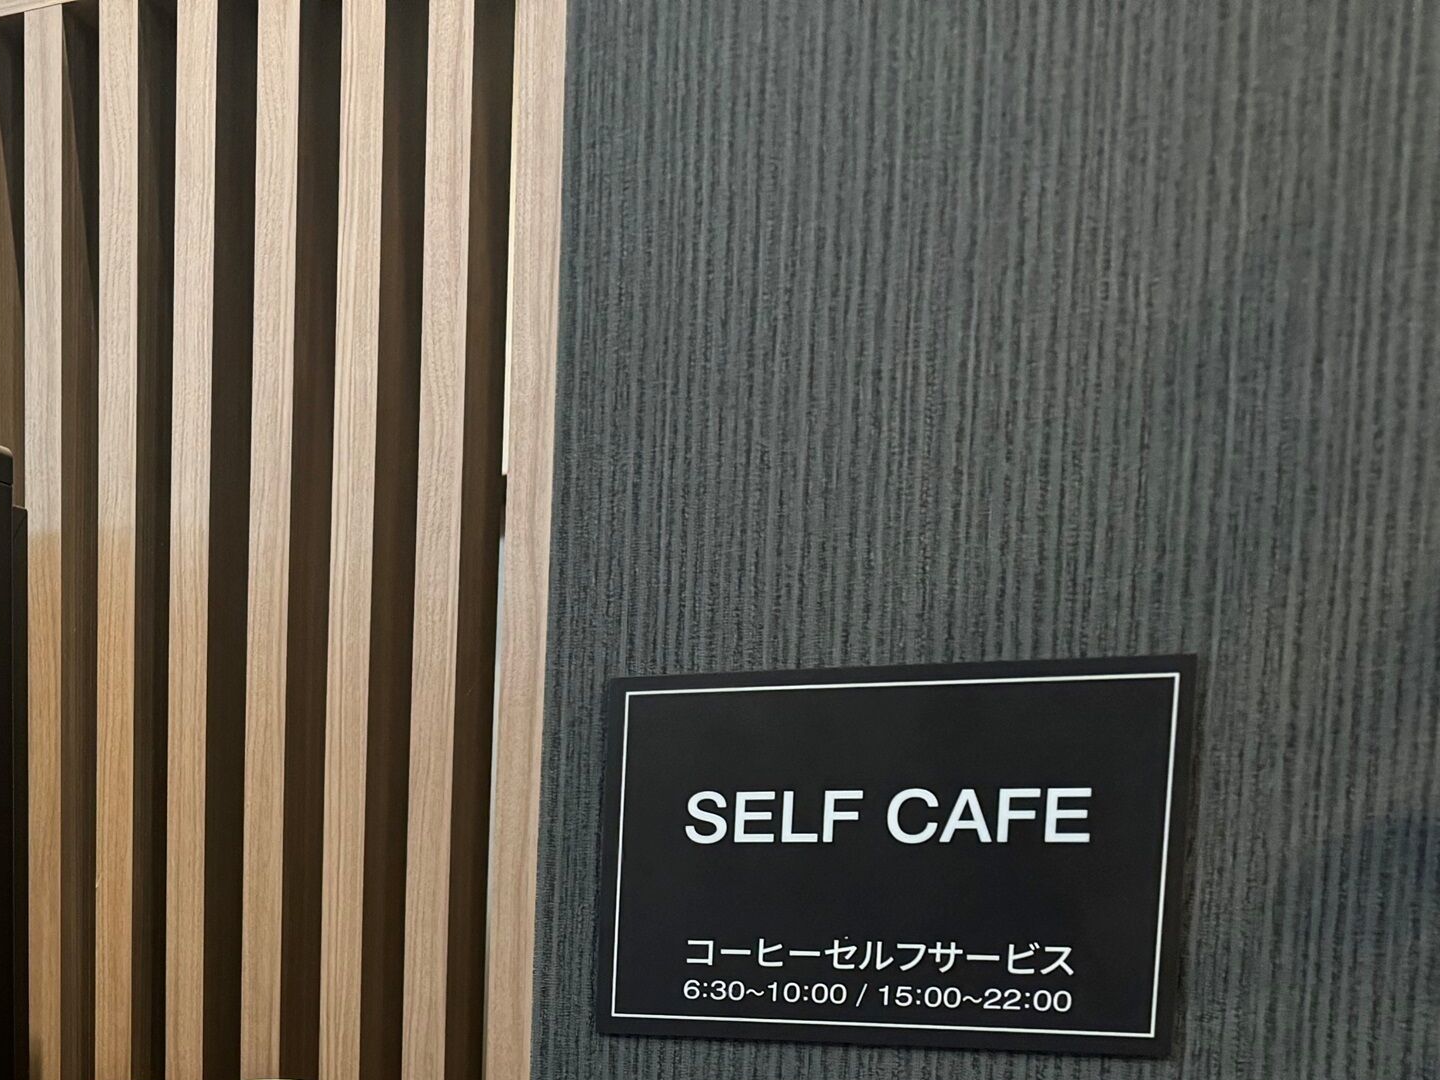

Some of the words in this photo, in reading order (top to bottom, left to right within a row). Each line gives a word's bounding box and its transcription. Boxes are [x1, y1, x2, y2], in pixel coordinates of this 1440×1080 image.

[684, 789, 864, 845] SELF
[886, 786, 1093, 845] CAFE
[685, 936, 1075, 977] コーヒーセルフサービス
[855, 982, 869, 1008] /
